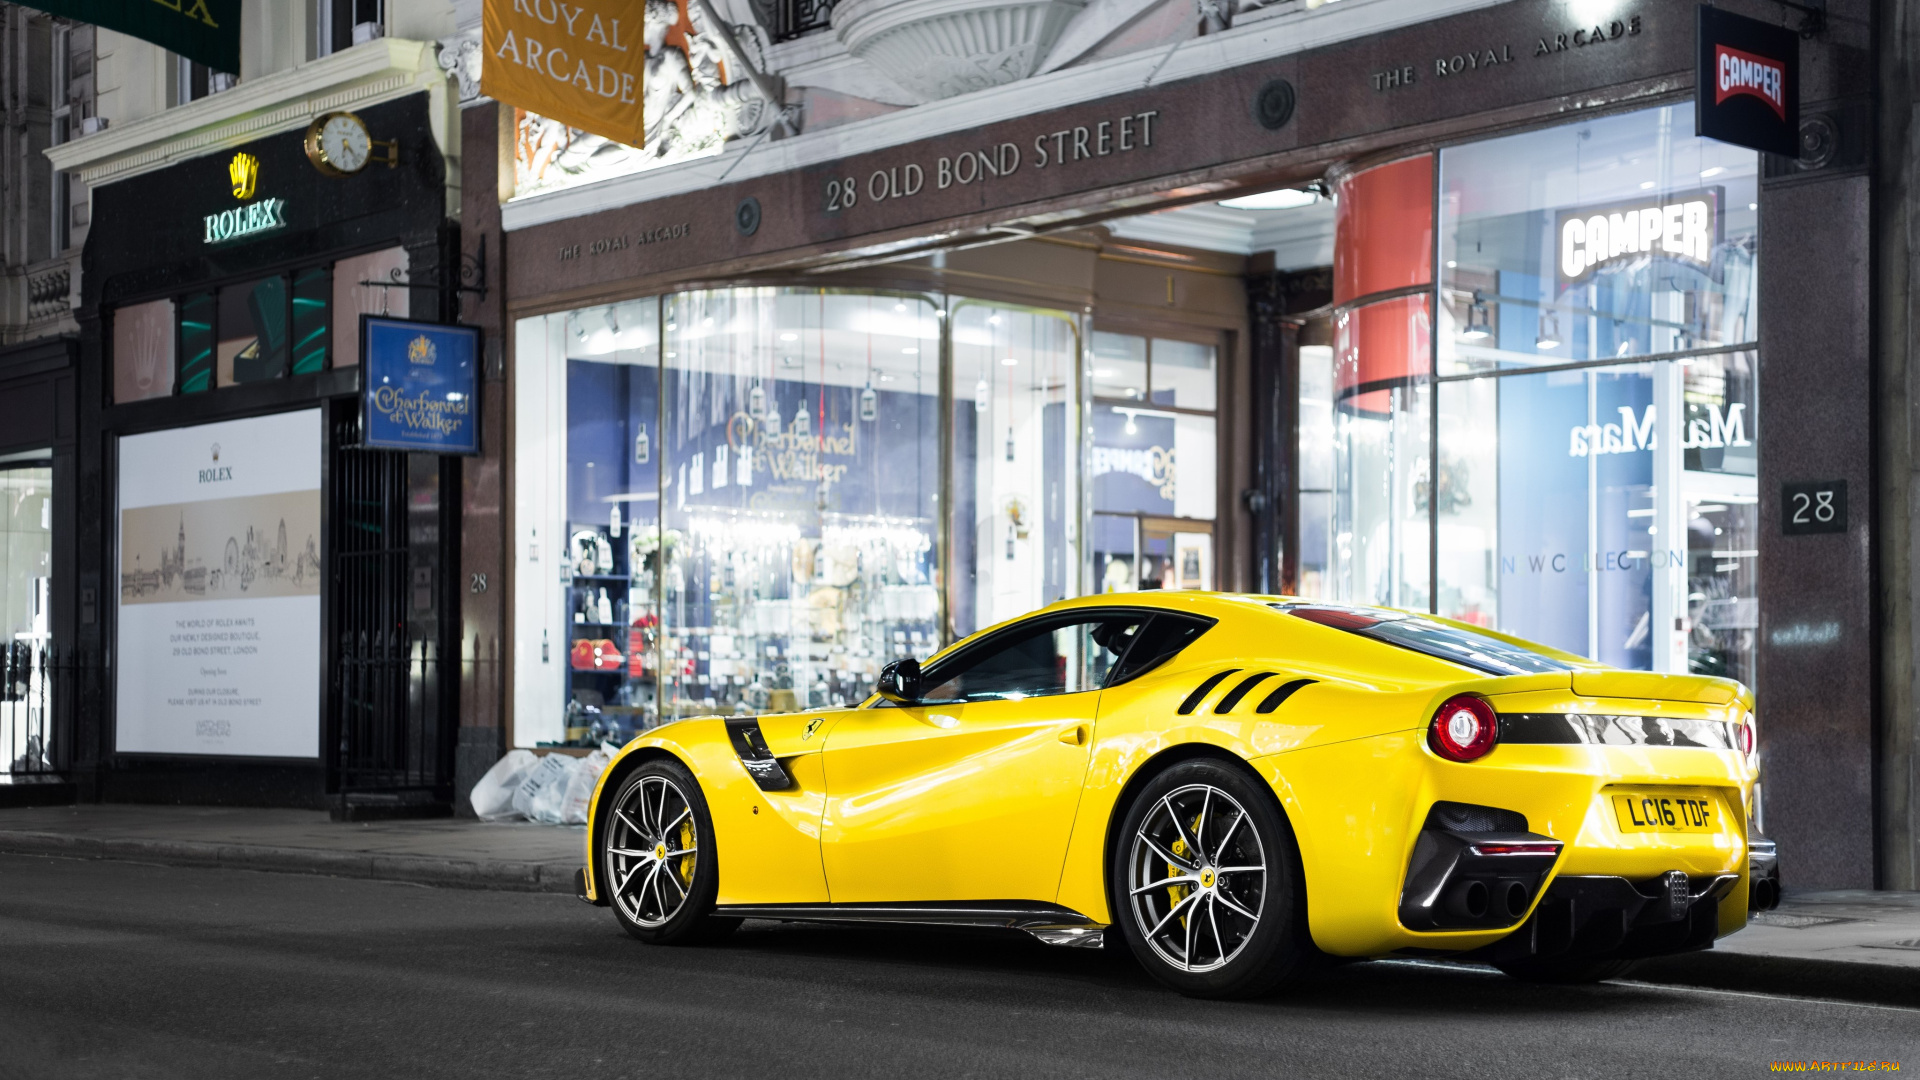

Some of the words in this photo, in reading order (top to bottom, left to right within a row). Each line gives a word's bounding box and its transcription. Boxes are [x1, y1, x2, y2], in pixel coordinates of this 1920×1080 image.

[496, 29, 636, 105] ARCADE
[1373, 66, 1415, 91] THE
[1435, 45, 1515, 77] ROYAL
[1534, 15, 1642, 58] ARCADE
[1719, 52, 1782, 107] CAMPER
[827, 176, 857, 212] 28
[868, 163, 924, 202] OLD
[938, 142, 1021, 190] BOND
[1035, 111, 1157, 169] STREET
[203, 198, 280, 243] ROLEX
[560, 244, 581, 261] THE
[590, 235, 629, 256] ROYAL
[638, 222, 690, 246] ARCADE
[1562, 200, 1708, 278] CAMPER
[375, 386, 469, 415] Charbonnel
[404, 410, 462, 436] Walker
[727, 411, 855, 456] Chrbonnel
[199, 466, 232, 483] ROLEX
[767, 449, 847, 483] Walker
[1792, 491, 1835, 524] 28
[470, 573, 487, 594] 28
[187, 619, 205, 628] WORLD
[1626, 798, 1676, 826] LC16
[1675, 799, 1710, 827] TDF
